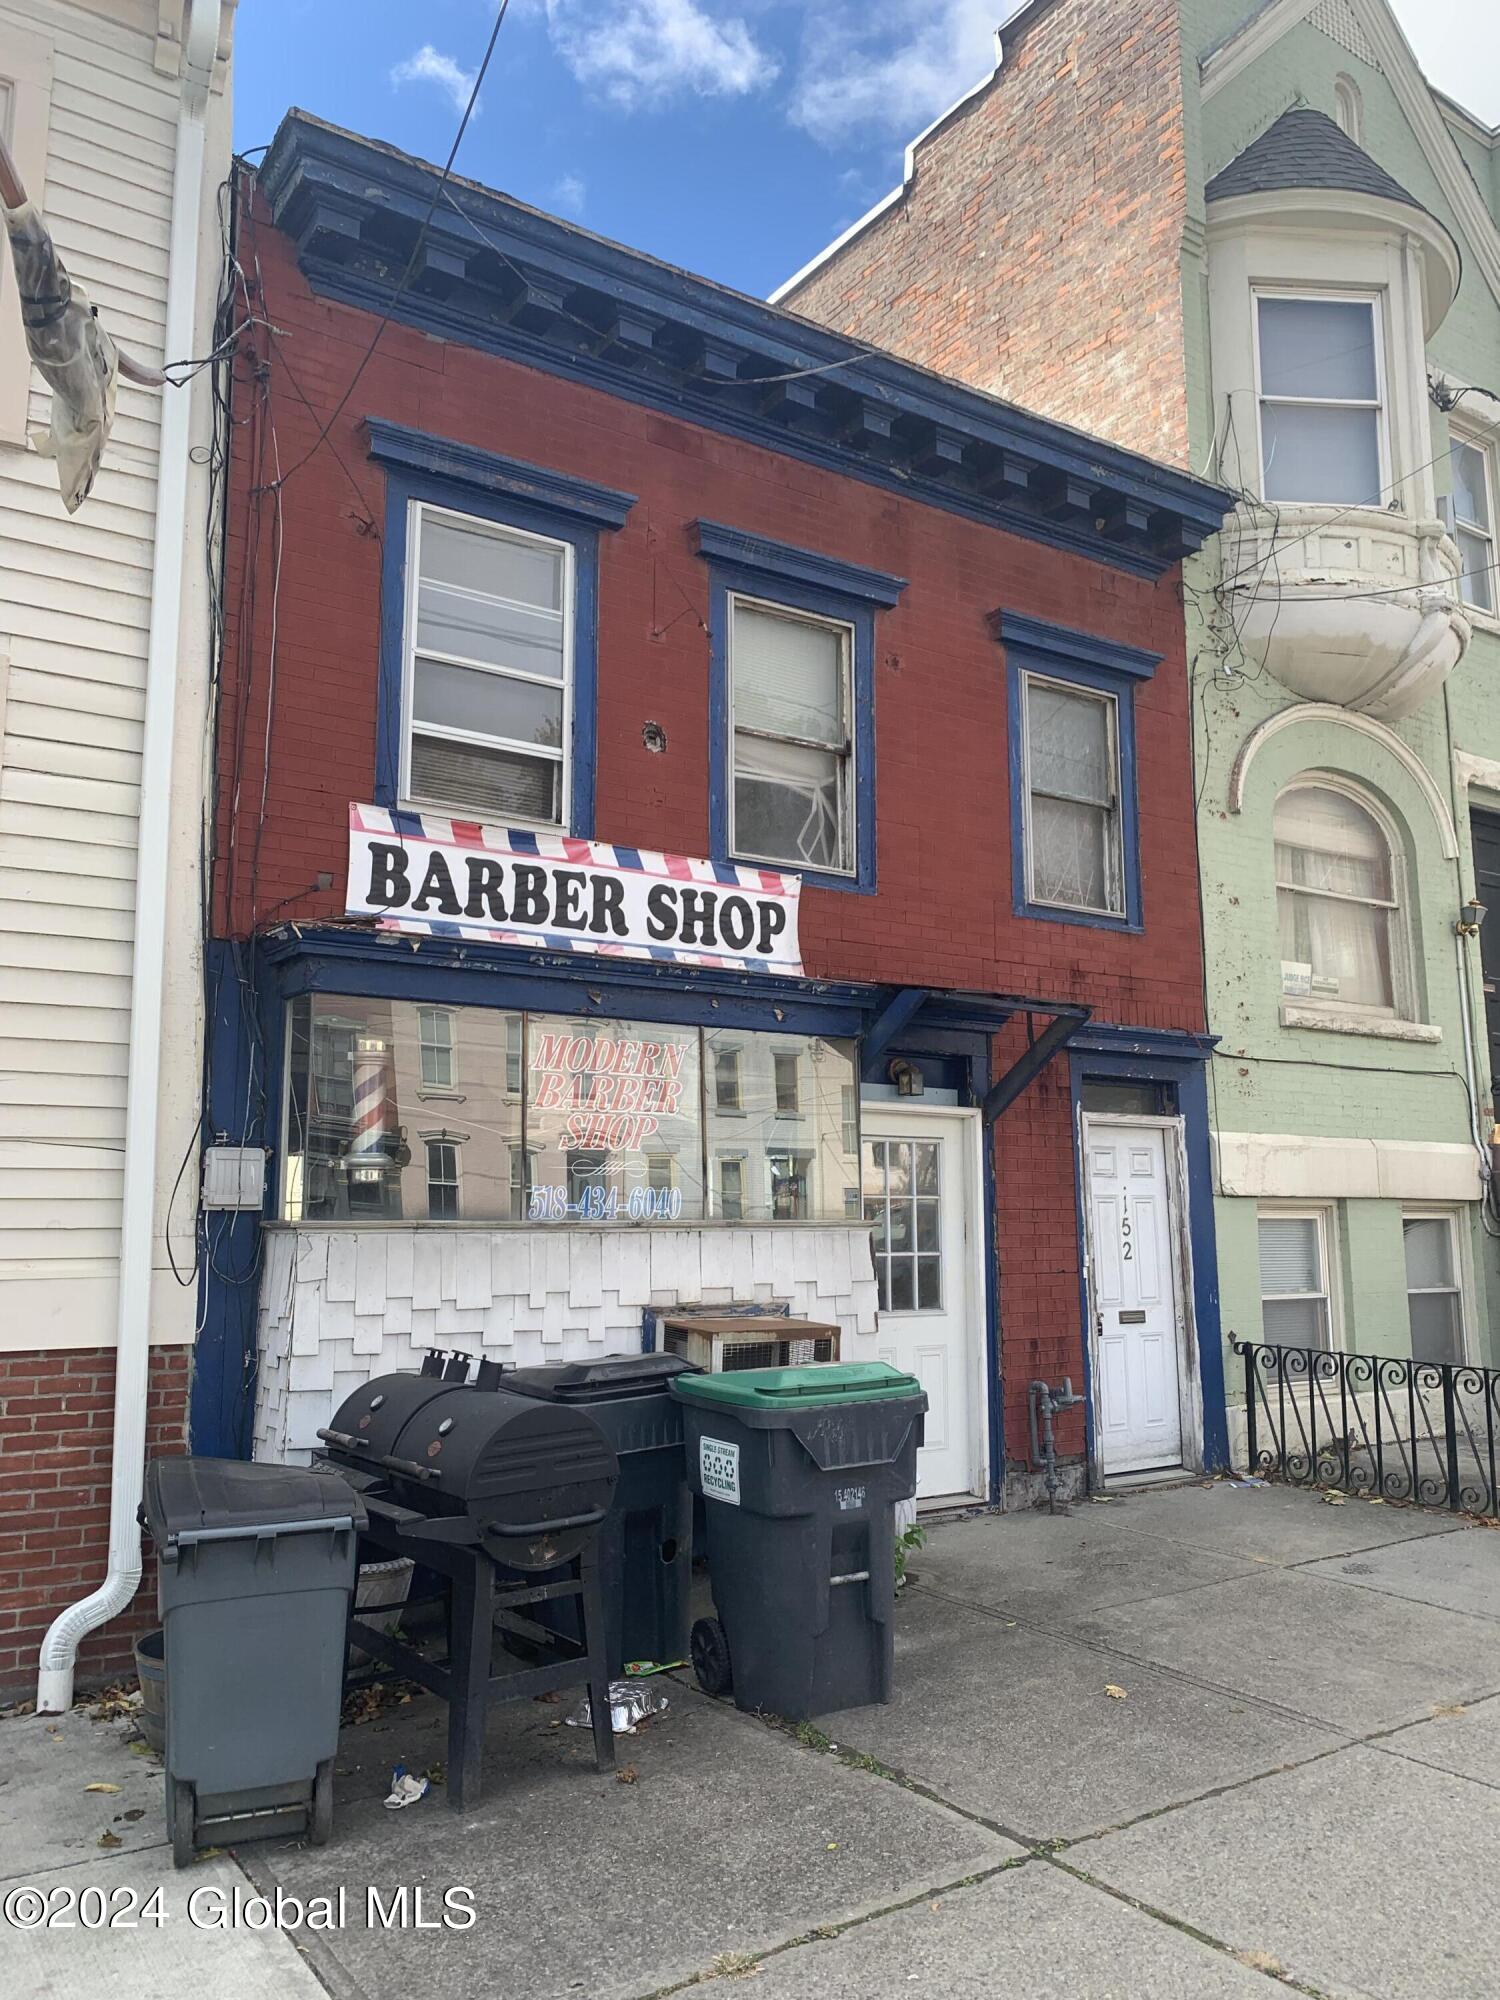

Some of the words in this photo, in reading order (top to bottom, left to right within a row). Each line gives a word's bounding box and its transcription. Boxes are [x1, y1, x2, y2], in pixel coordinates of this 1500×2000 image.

[366, 841, 630, 936] BARBER
[646, 883, 786, 954] SHOP
[531, 1034, 688, 1079] MODERN
[532, 1073, 684, 1115] BARBER
[558, 1112, 659, 1151] SHOP
[529, 1184, 682, 1220] 518-434-6040
[703, 1442, 717, 1454] SINGLE
[717, 1446, 735, 1458] STREAM
[703, 1473, 736, 1492] RECYCLING
